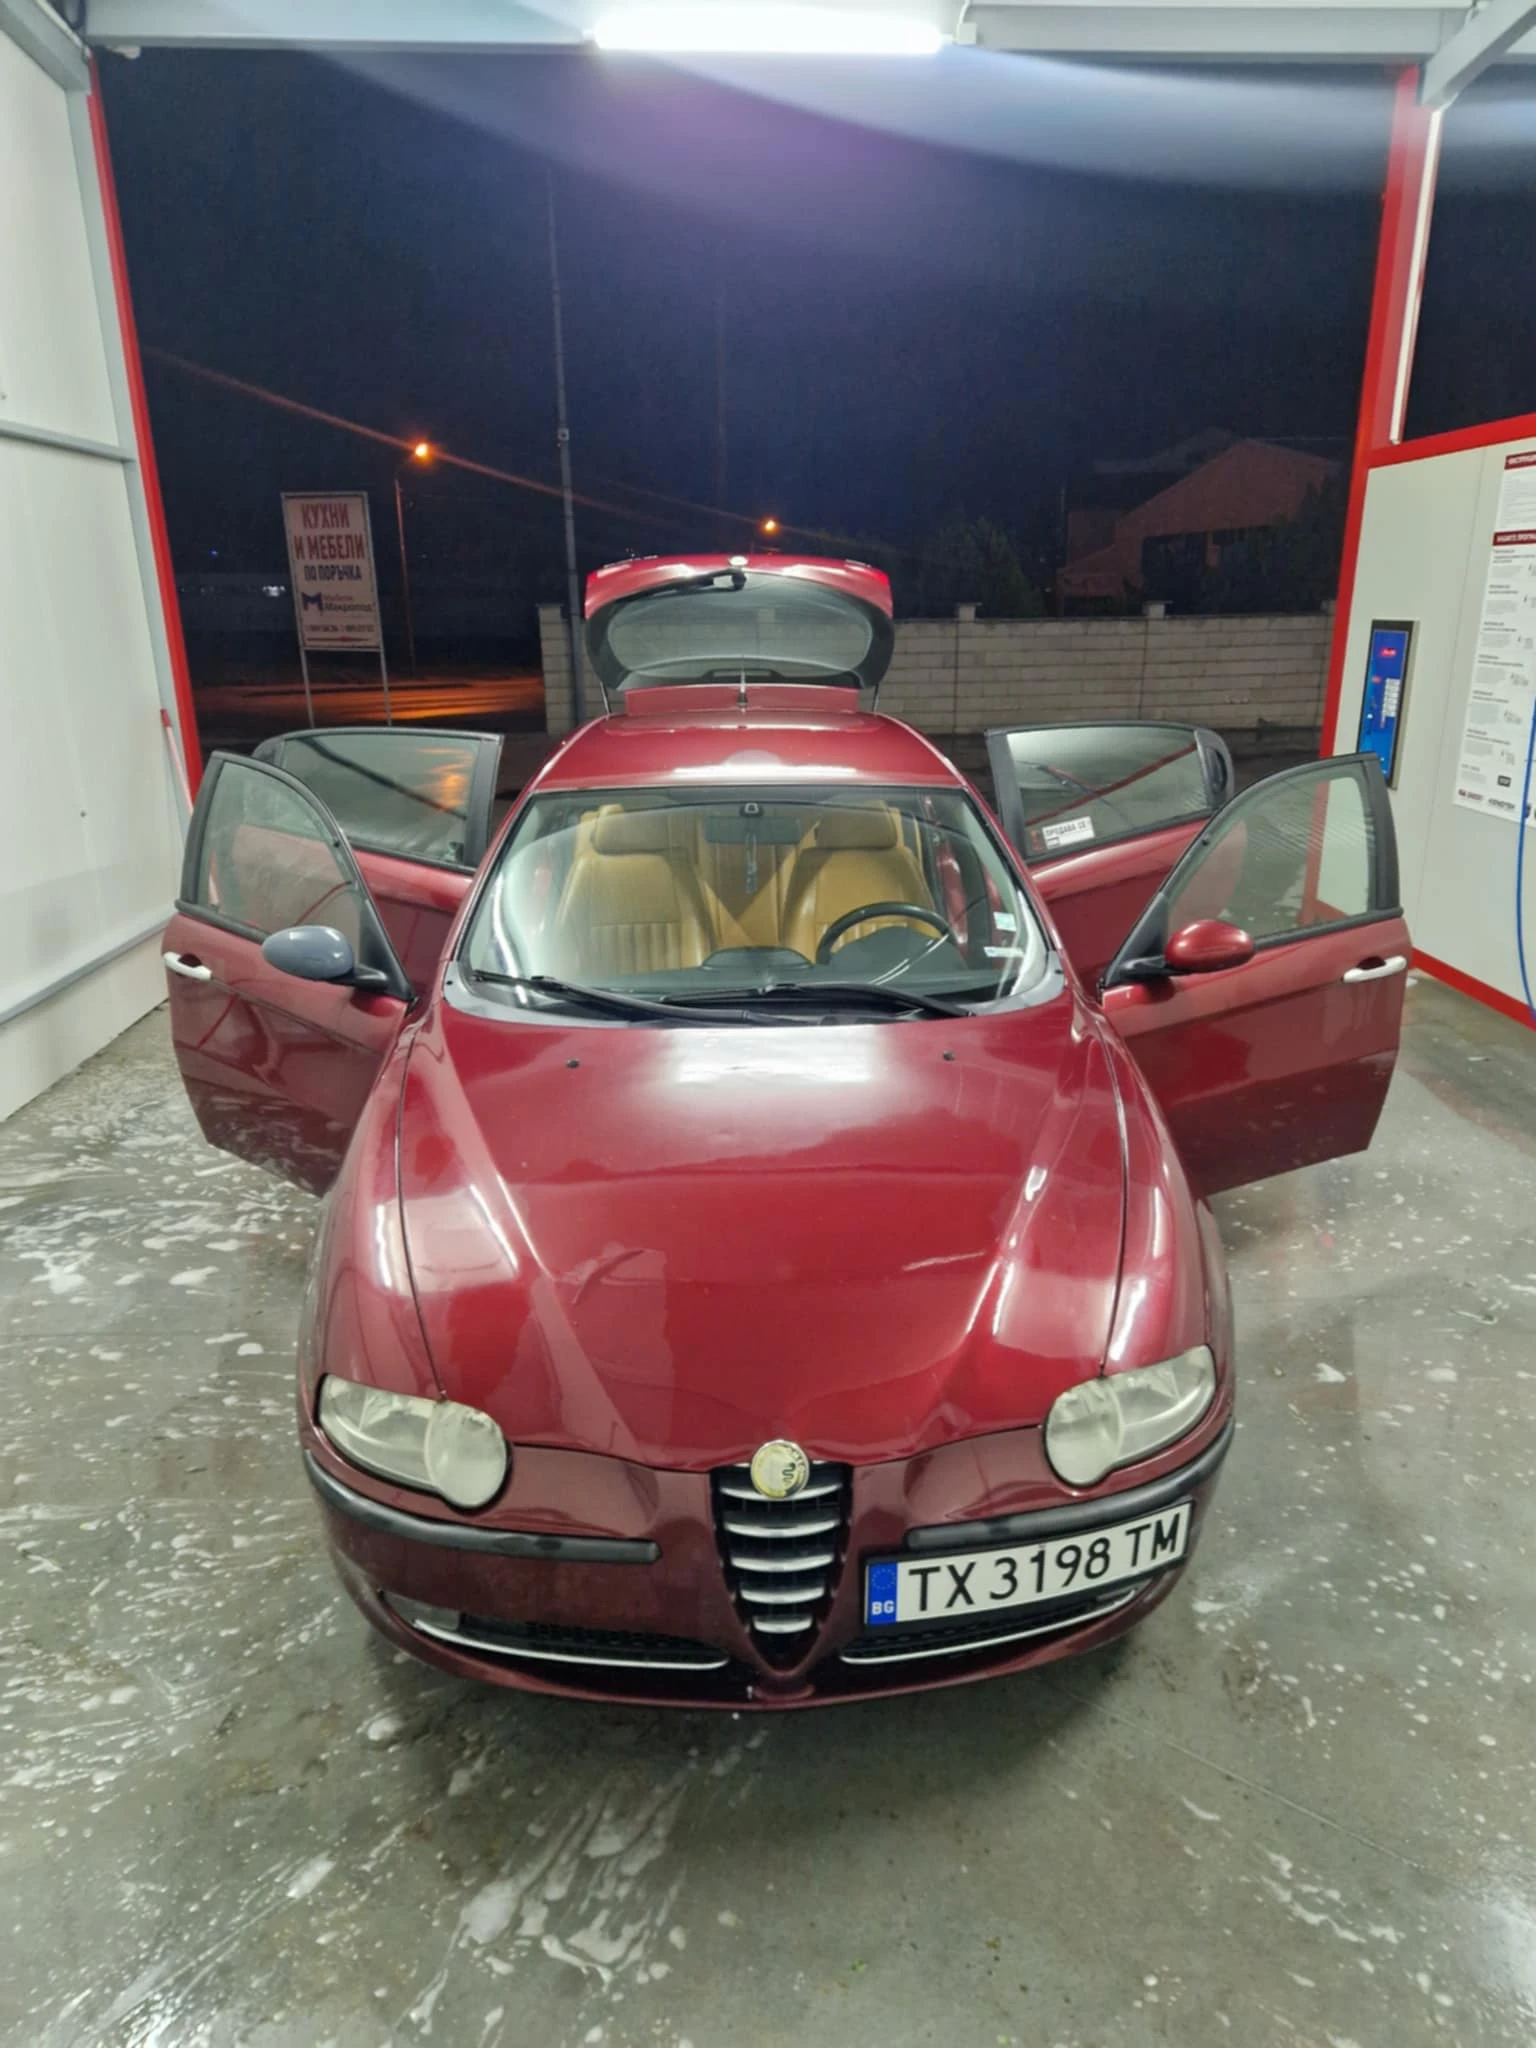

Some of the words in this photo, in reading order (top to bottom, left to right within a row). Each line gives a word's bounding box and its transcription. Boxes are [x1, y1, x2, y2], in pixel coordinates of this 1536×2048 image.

[301, 503, 350, 529] КУХНИ
[294, 535, 305, 561] И
[307, 533, 365, 560] МЕБЕЛИ
[304, 564, 317, 582] ПО
[318, 564, 362, 582] ПОРЪЧКА
[908, 1561, 976, 1612] TX
[990, 1537, 1110, 1601] 3198
[1125, 1512, 1180, 1568] TM
[871, 1600, 895, 1615] BG
